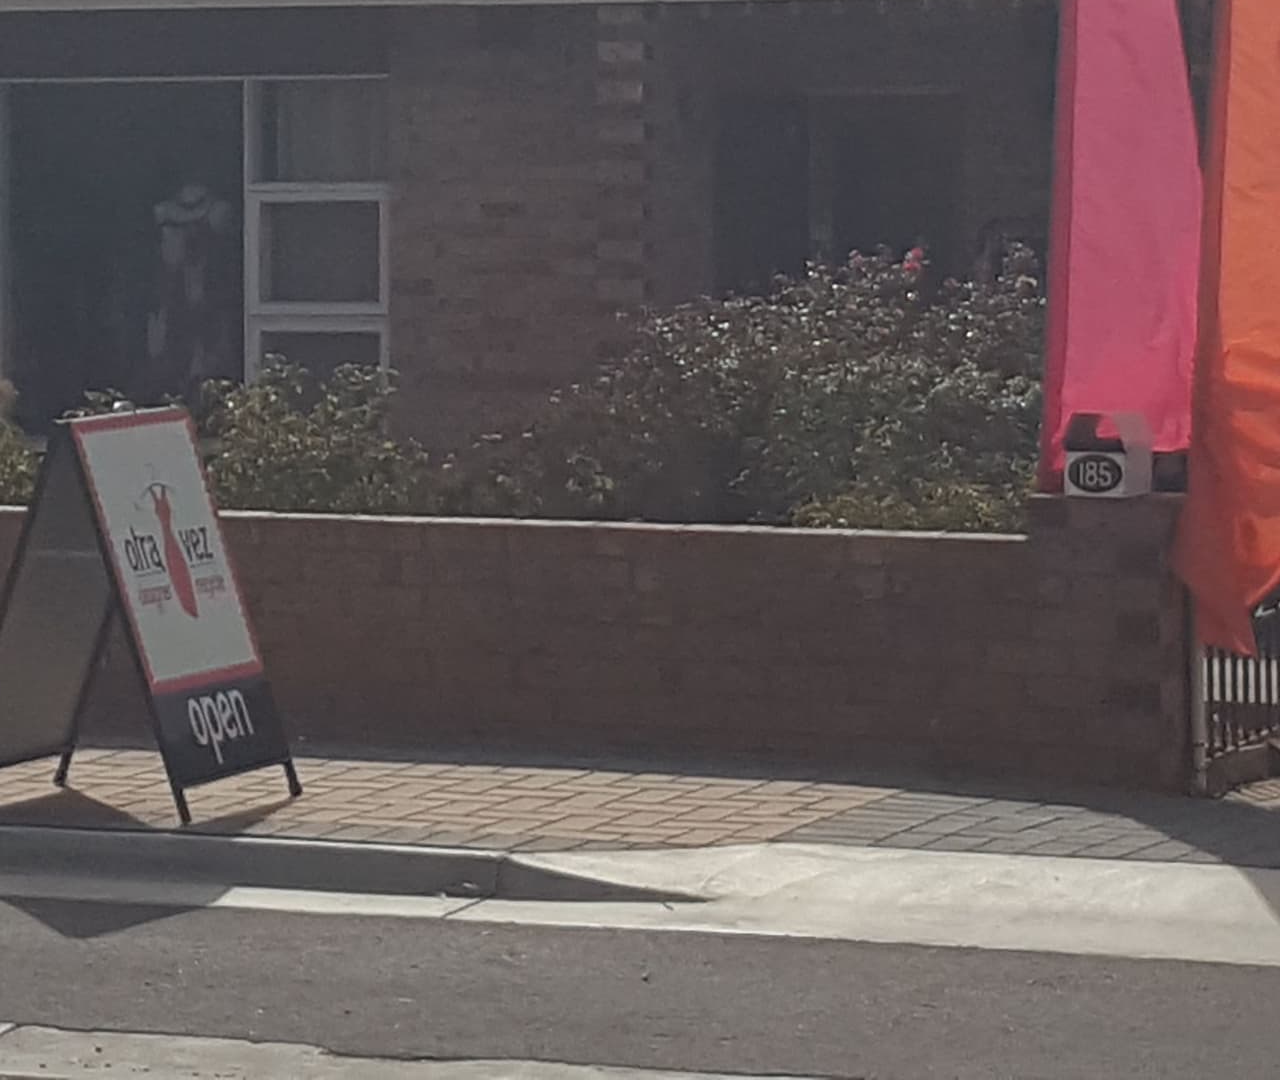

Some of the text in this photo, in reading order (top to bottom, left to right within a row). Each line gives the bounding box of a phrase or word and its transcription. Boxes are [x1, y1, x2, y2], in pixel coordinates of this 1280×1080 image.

[1078, 461, 1113, 486] 185
[125, 525, 214, 572] otra vez
[189, 689, 254, 764] open
